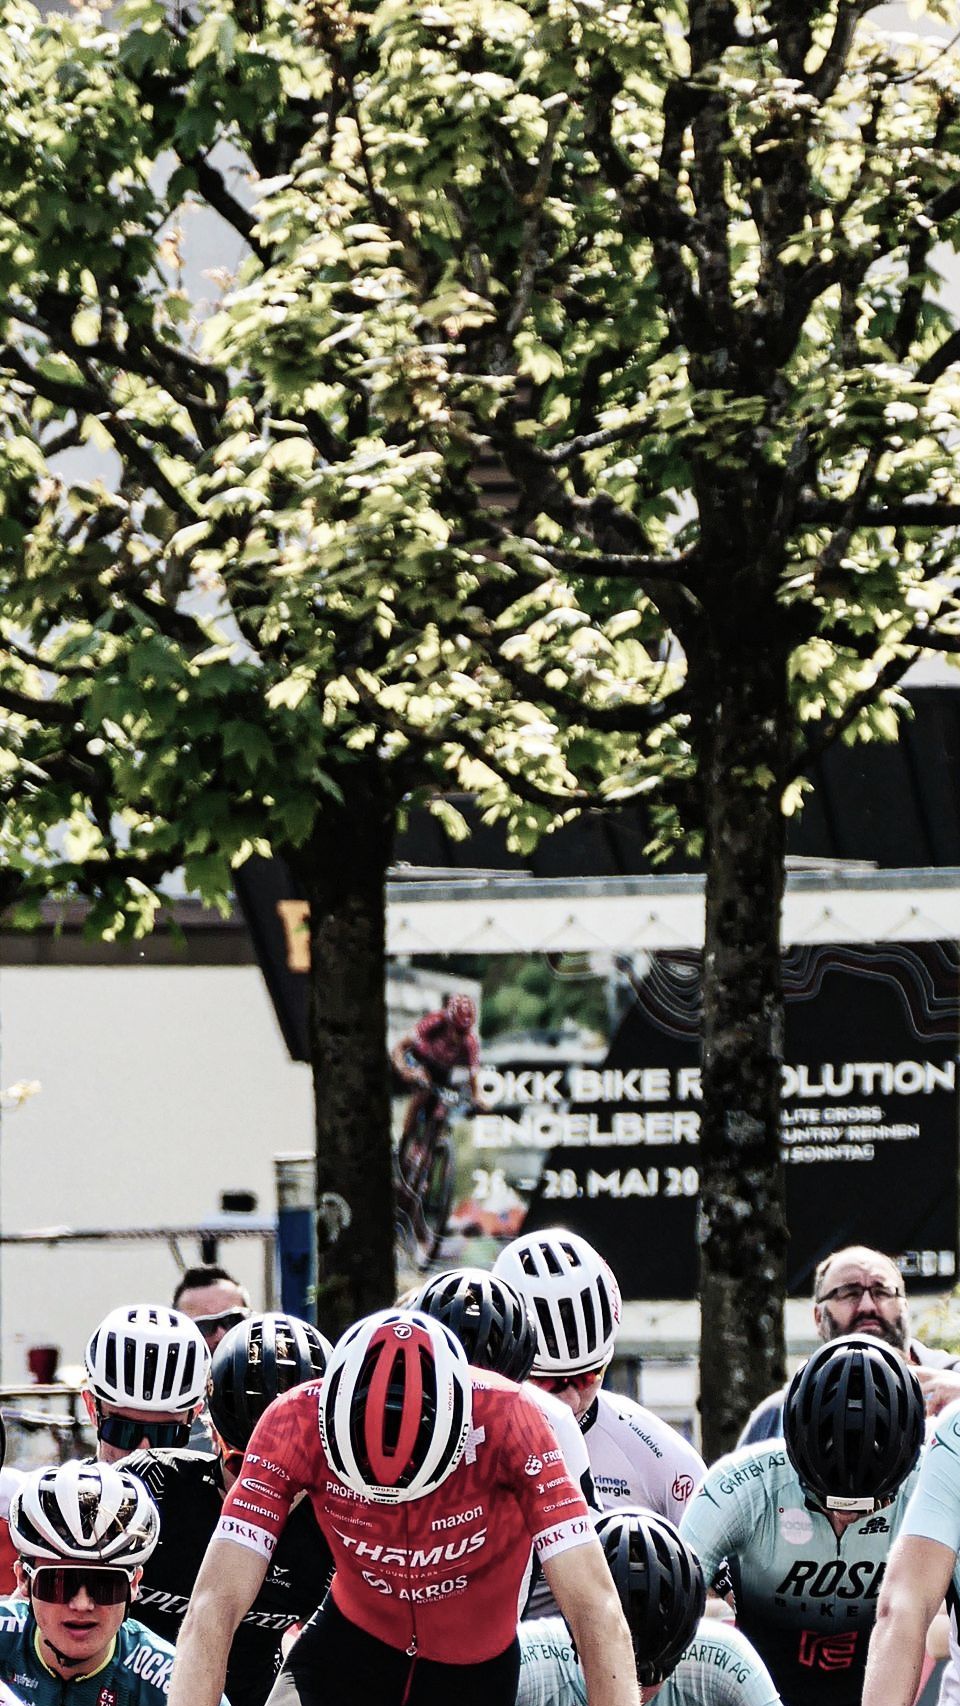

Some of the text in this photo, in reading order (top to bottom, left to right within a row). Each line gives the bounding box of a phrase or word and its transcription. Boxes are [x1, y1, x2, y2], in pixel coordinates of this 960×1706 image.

[570, 1067, 671, 1101] BIKE
[677, 1060, 956, 1101] ROLUTION
[781, 1107, 820, 1125] LITE
[472, 1110, 702, 1149] ENGELBER
[782, 1122, 920, 1145] UNTRY RENNEN
[789, 1143, 876, 1164] SONNTAG
[586, 1165, 659, 1199] MAI
[663, 1165, 700, 1198] 20
[628, 1420, 665, 1460] vaudoise
[245, 1453, 261, 1465] DT
[594, 1475, 628, 1488] rimeo
[719, 1461, 764, 1495] GARTEN
[232, 1497, 281, 1522] SHIMANO
[431, 1505, 484, 1532] maxon
[222, 1520, 258, 1543] ÖKK
[399, 1574, 469, 1601] AKROS
